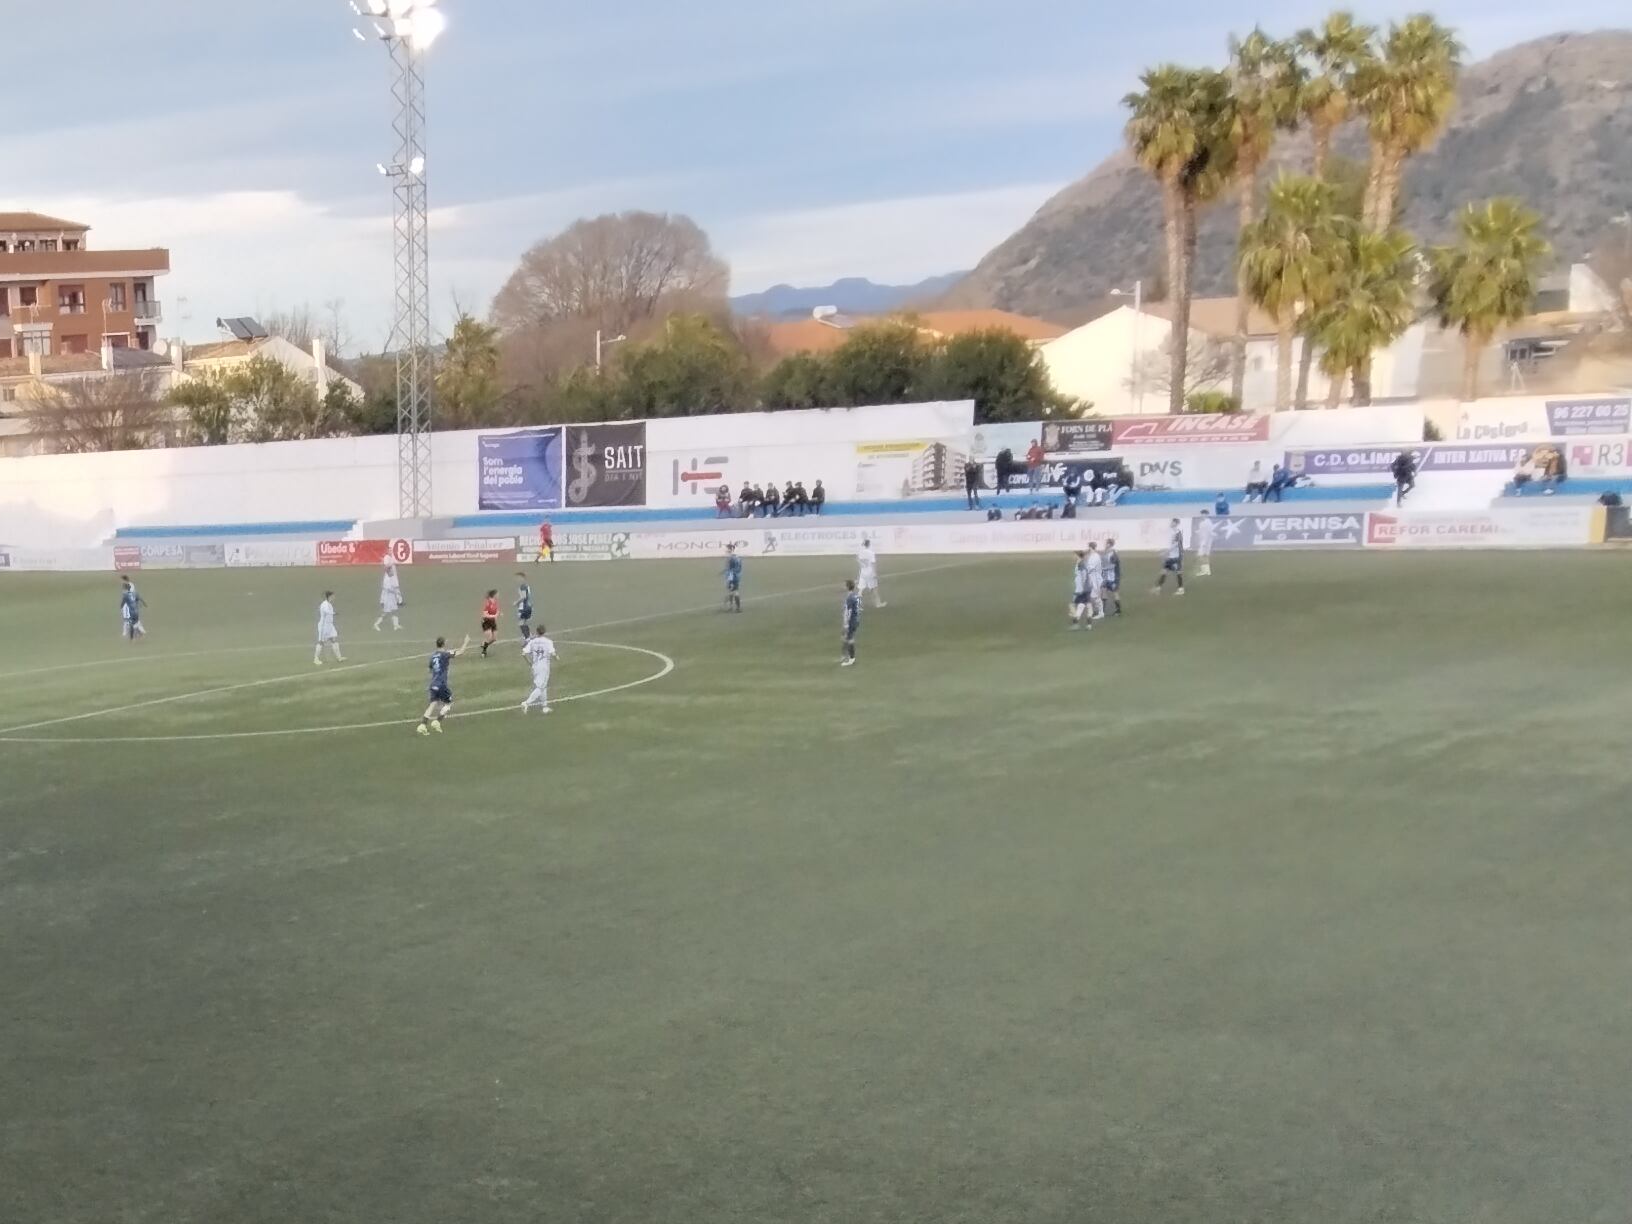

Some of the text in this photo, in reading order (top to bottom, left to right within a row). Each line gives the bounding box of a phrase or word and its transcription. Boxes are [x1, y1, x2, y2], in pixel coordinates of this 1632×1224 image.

[1570, 406, 1594, 418] 227
[1167, 414, 1259, 431] INCASE
[483, 456, 503, 466] Som
[604, 445, 644, 469] SAIT
[1314, 453, 1344, 467] C.D.
[1598, 444, 1623, 466] R3
[1255, 516, 1360, 531] VERNISA
[1378, 525, 1430, 536] REFOR
